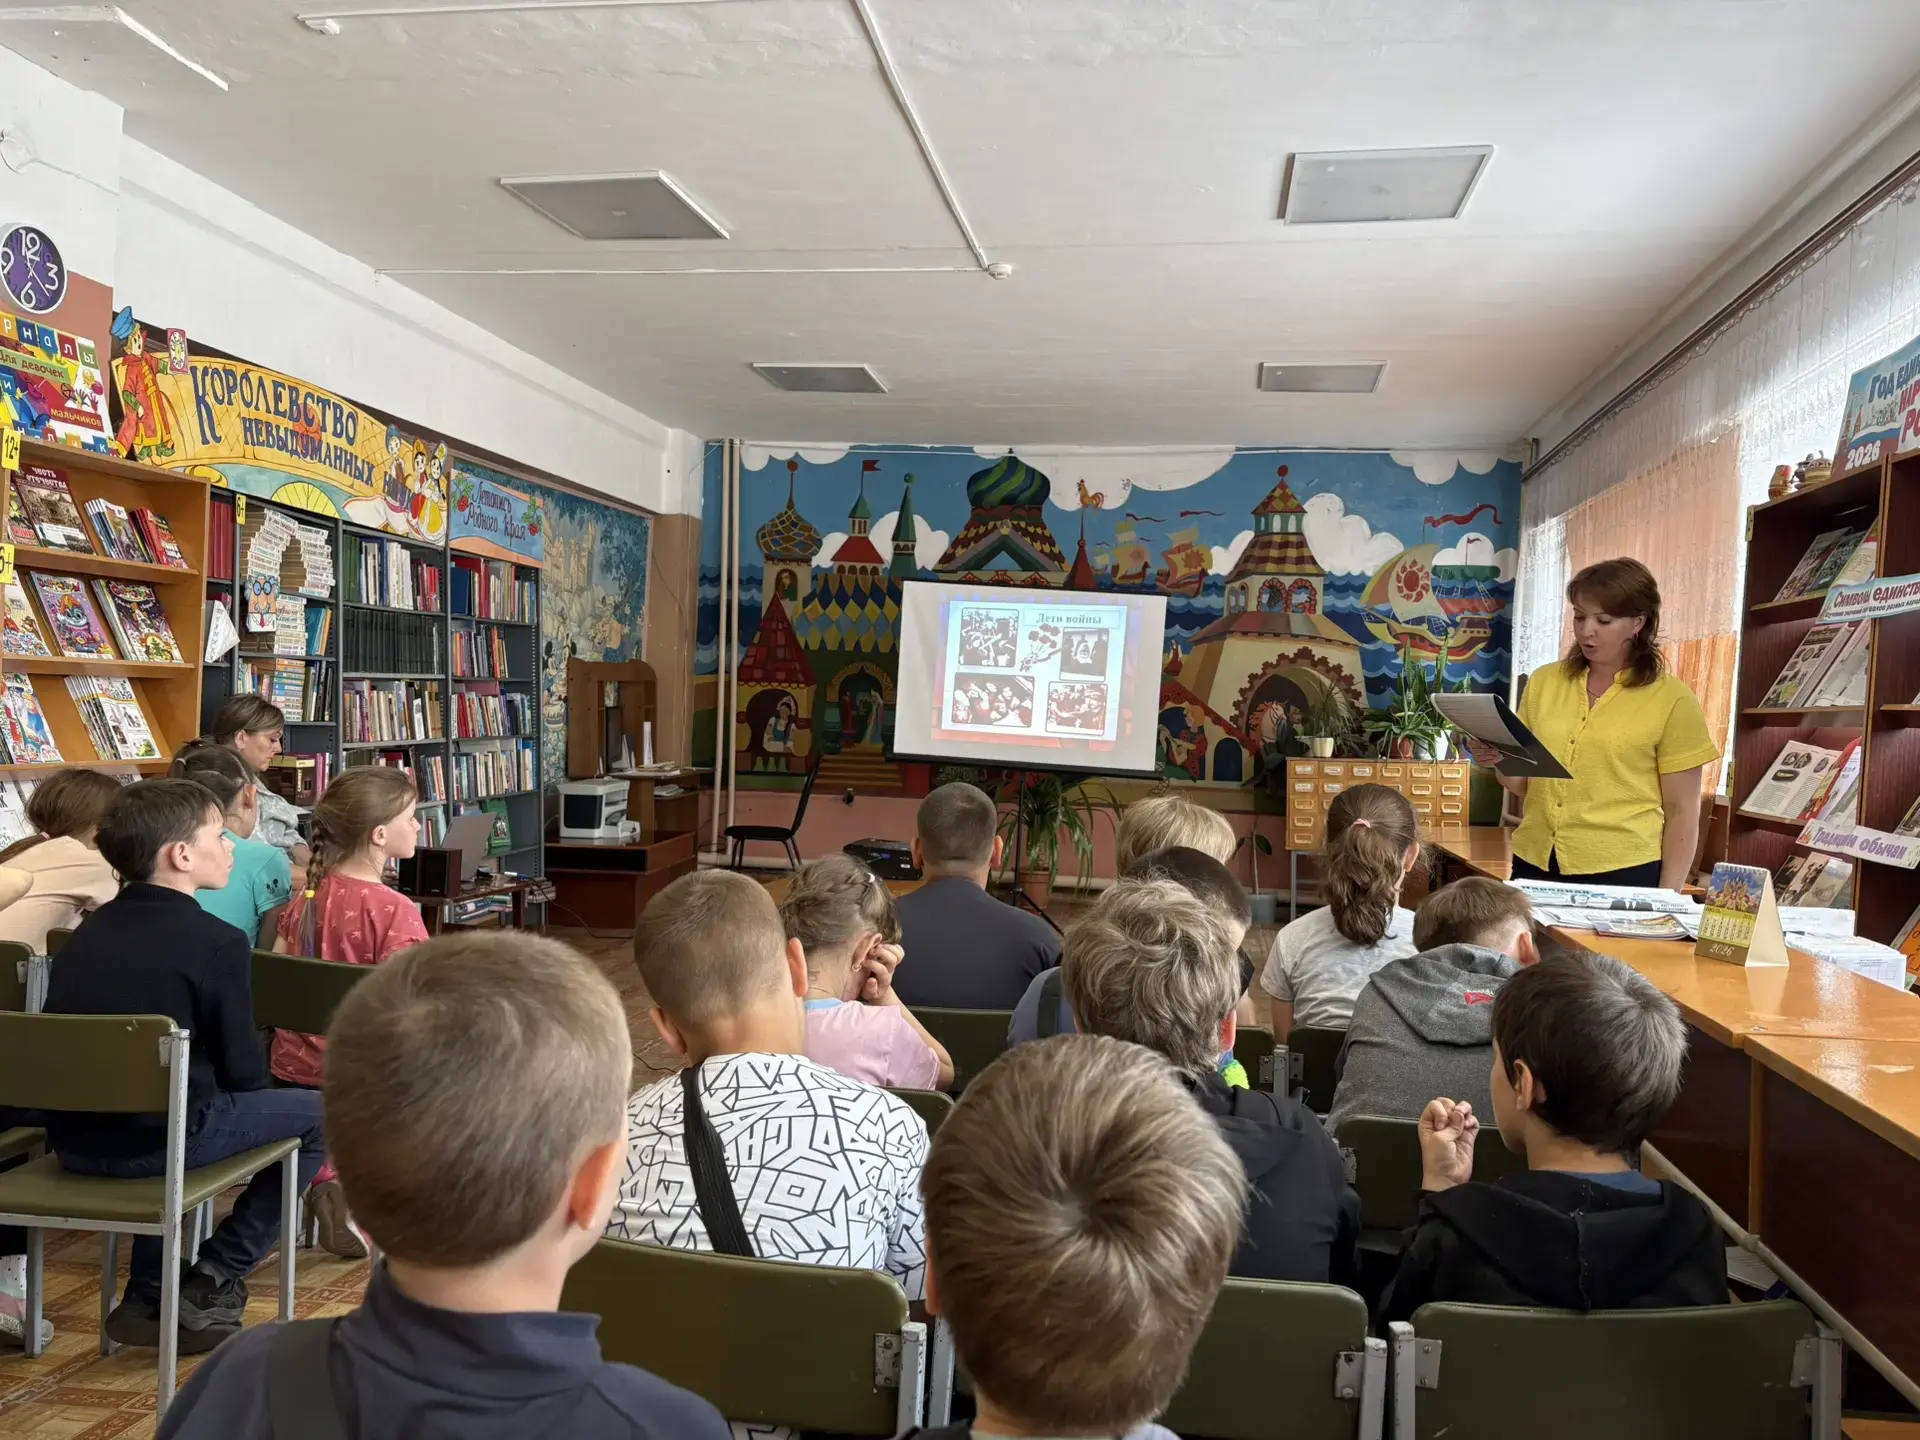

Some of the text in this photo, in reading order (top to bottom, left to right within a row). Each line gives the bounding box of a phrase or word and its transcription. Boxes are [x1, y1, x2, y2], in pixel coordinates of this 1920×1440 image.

[18, 228, 41, 262] 12
[44, 262, 59, 291] 3
[20, 281, 37, 308] 6
[21, 359, 65, 379] девочек
[50, 408, 102, 427] мальчиков
[4, 436, 19, 460] 12+
[241, 415, 375, 488] НЕВЫДУМАННЫХ
[1844, 439, 1881, 471] 2026
[471, 481, 512, 513] Летопись
[463, 502, 499, 534] Родного
[1035, 612, 1102, 625] Дети войны
[1709, 942, 1735, 957] 2026
